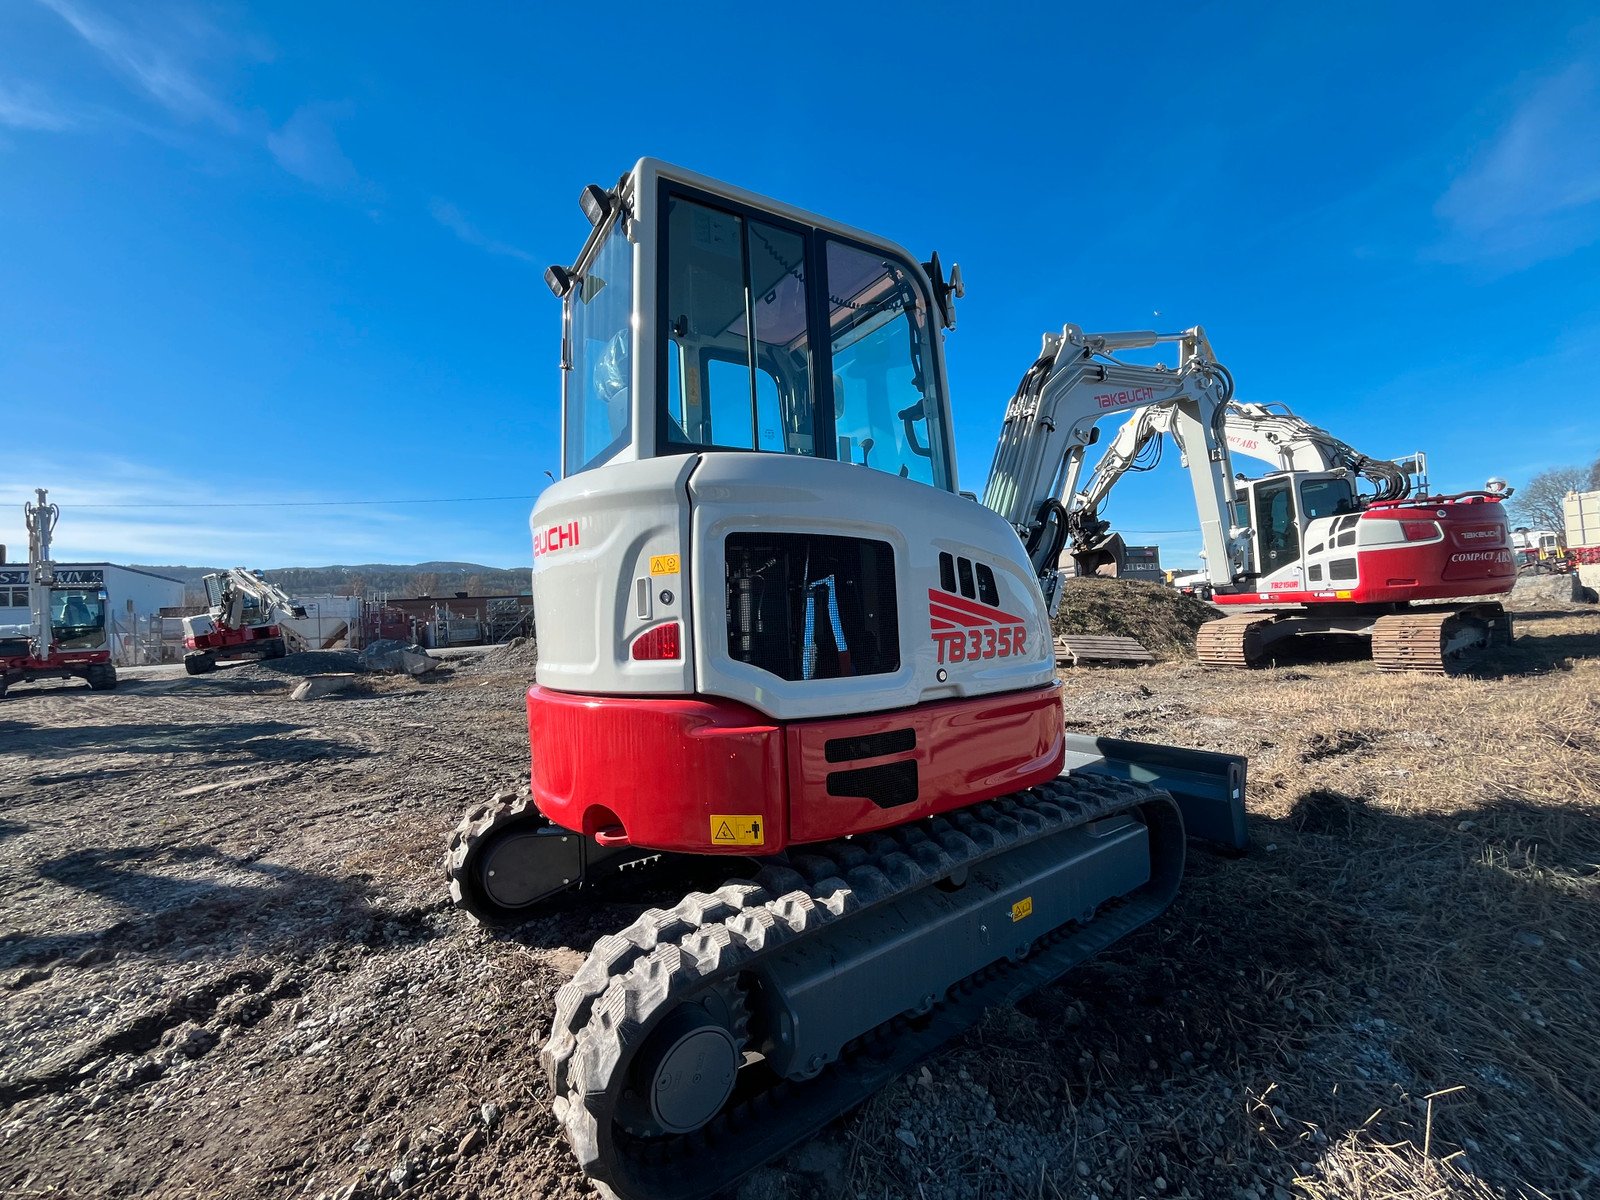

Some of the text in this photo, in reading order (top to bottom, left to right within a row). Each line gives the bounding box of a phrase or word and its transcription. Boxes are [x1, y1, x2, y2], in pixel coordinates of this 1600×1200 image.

[1461, 530, 1500, 539] TAKEUCH
[1451, 551, 1511, 563] COMPACT ABS
[931, 626, 1027, 665] TB335R
